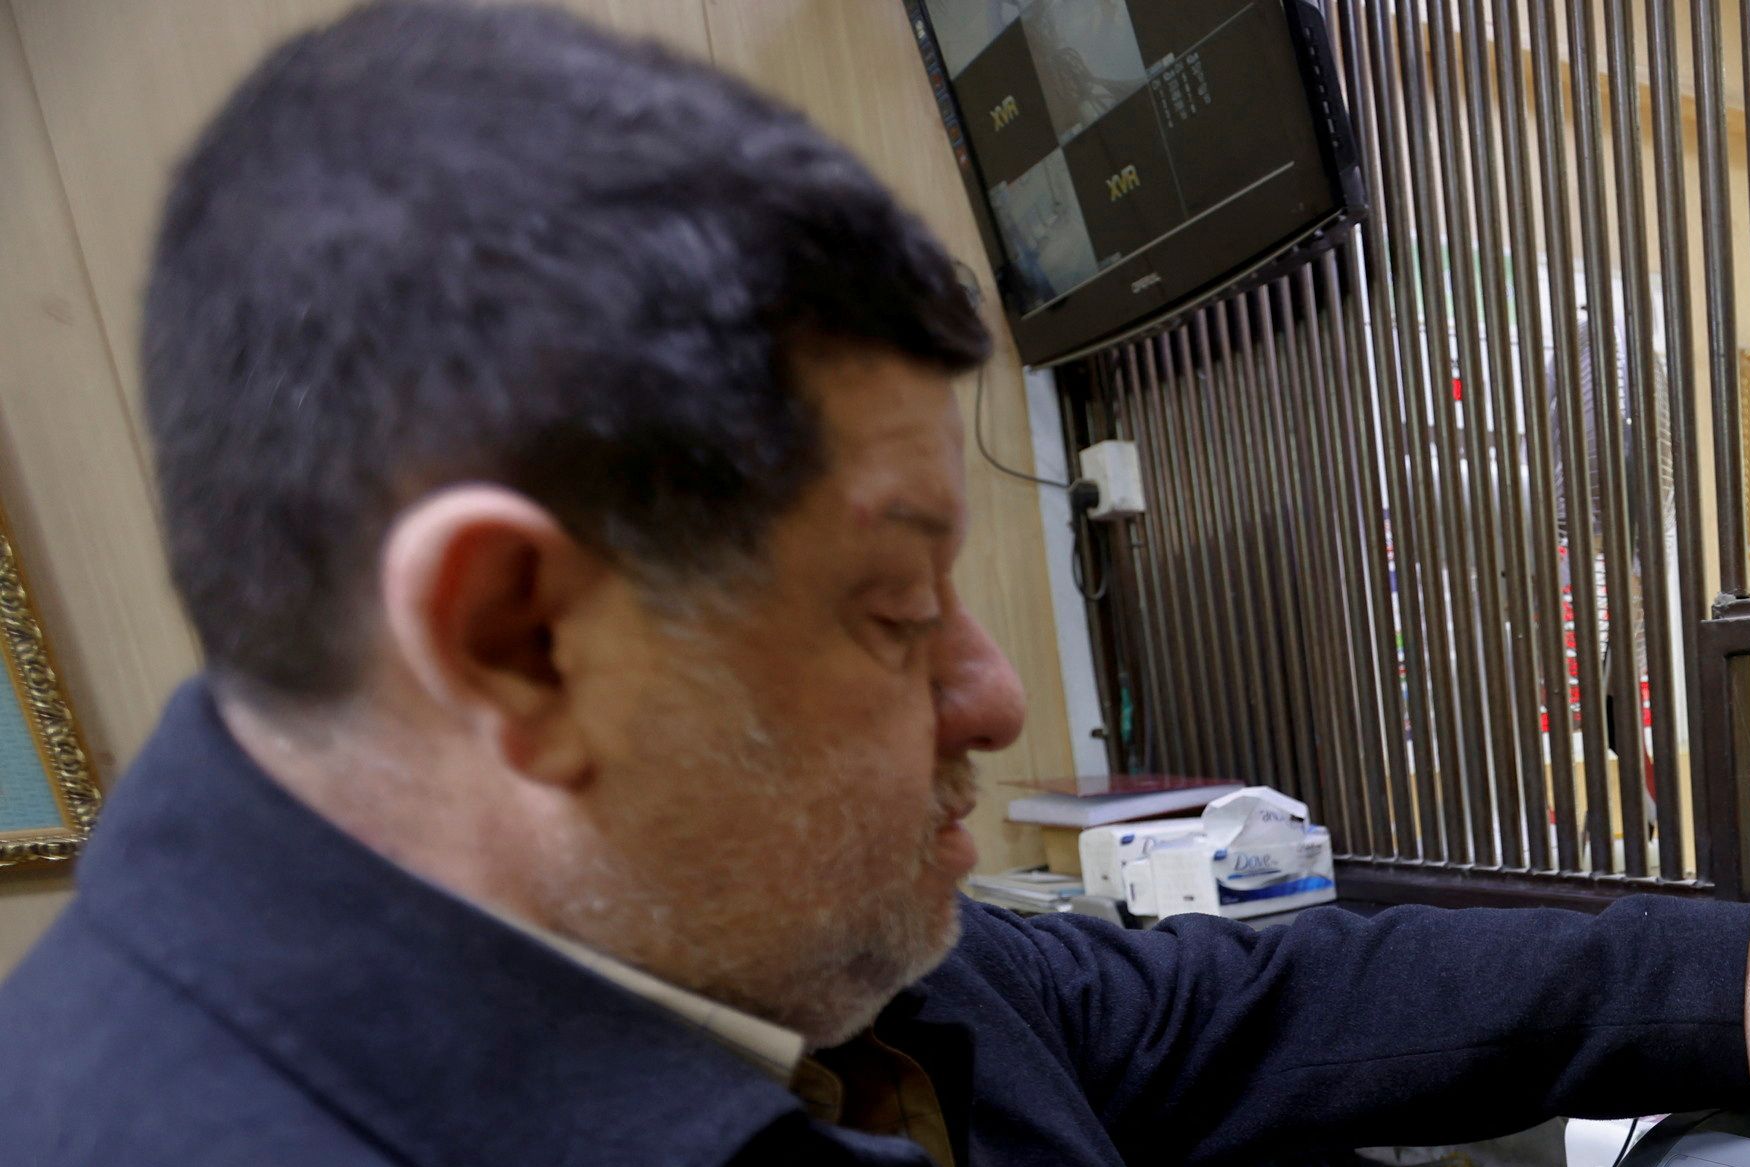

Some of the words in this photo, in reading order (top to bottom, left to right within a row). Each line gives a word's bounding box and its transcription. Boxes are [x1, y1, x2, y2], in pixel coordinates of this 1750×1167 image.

[989, 94, 1020, 132] XVR
[1105, 164, 1141, 202] XVR
[1234, 854, 1271, 871] Dove
